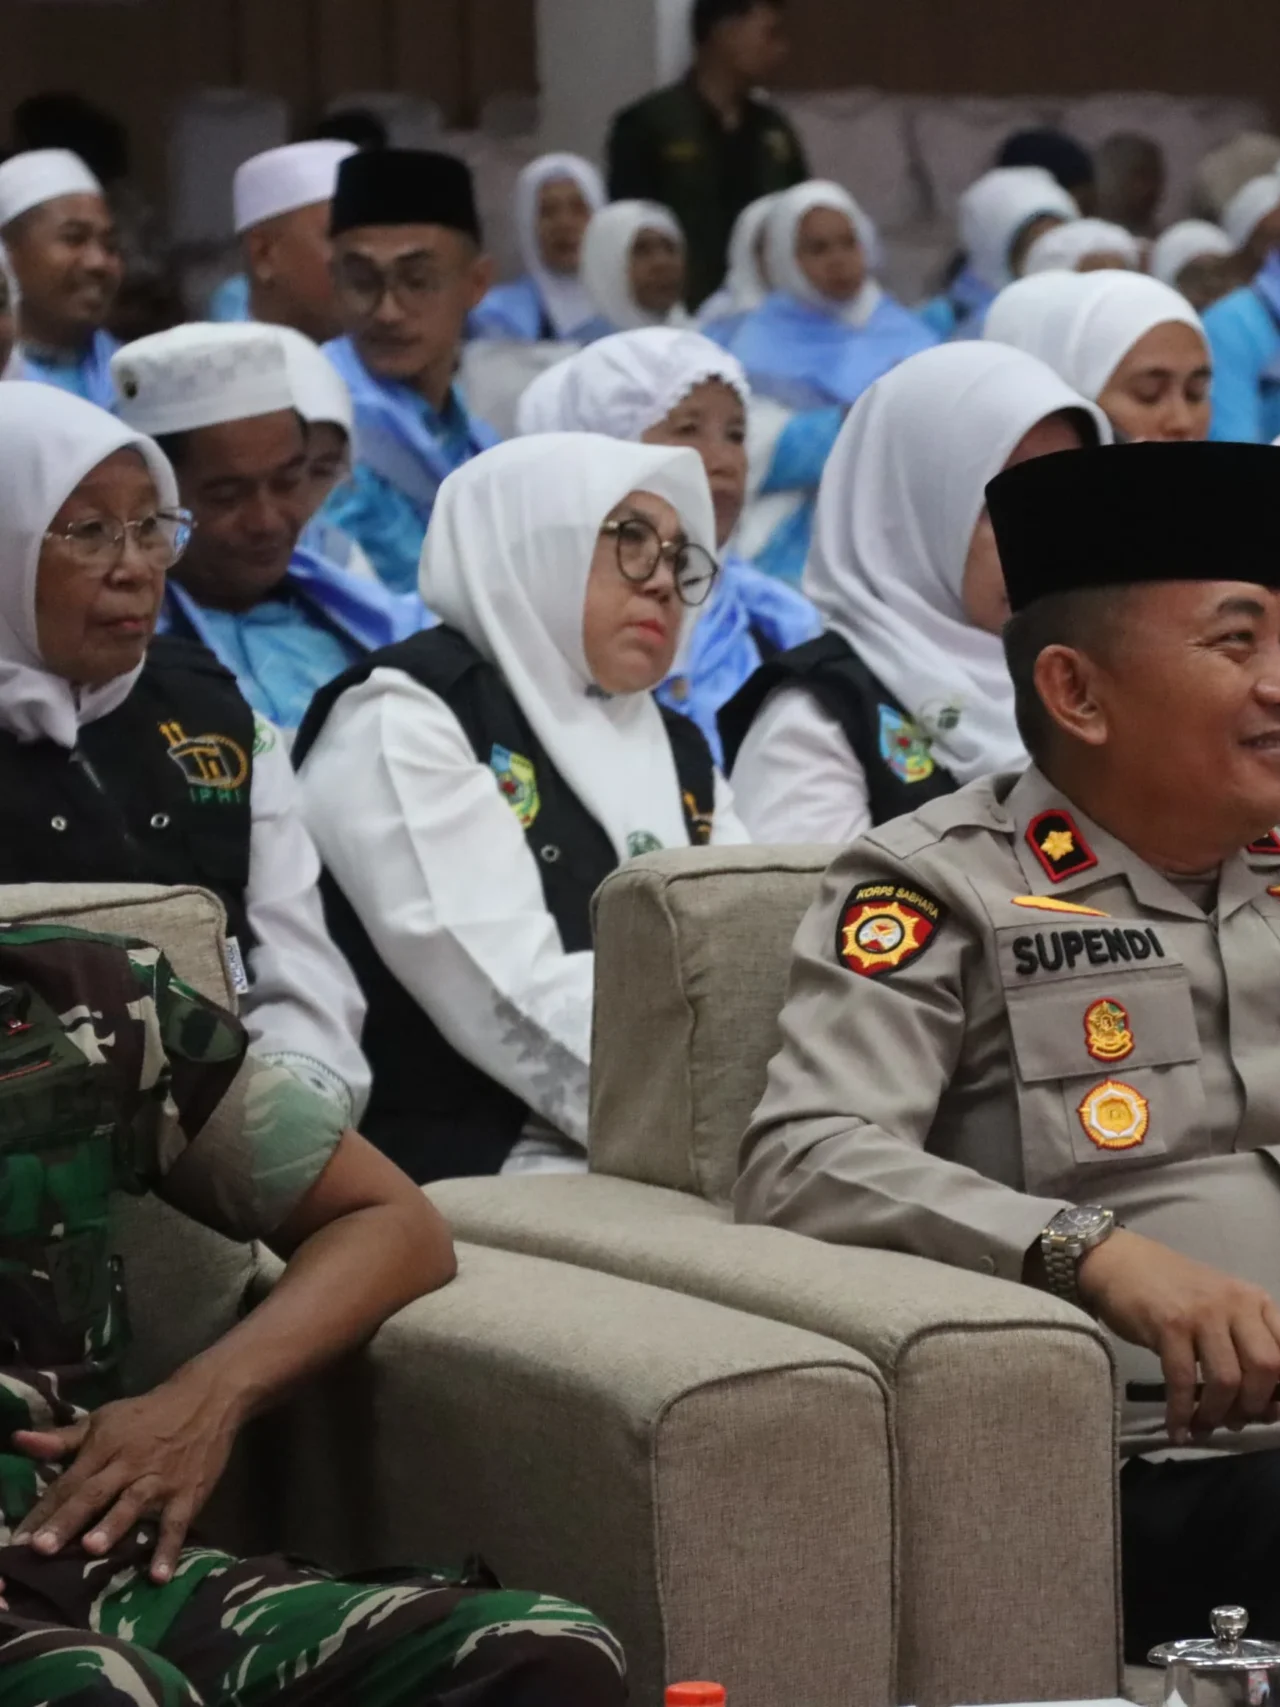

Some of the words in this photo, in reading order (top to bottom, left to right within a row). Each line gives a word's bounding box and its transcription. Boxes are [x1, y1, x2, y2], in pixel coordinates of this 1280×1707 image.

[856, 886, 895, 899] KORPS
[895, 887, 939, 919] SABHARA
[1012, 927, 1165, 974] SUPENDI
